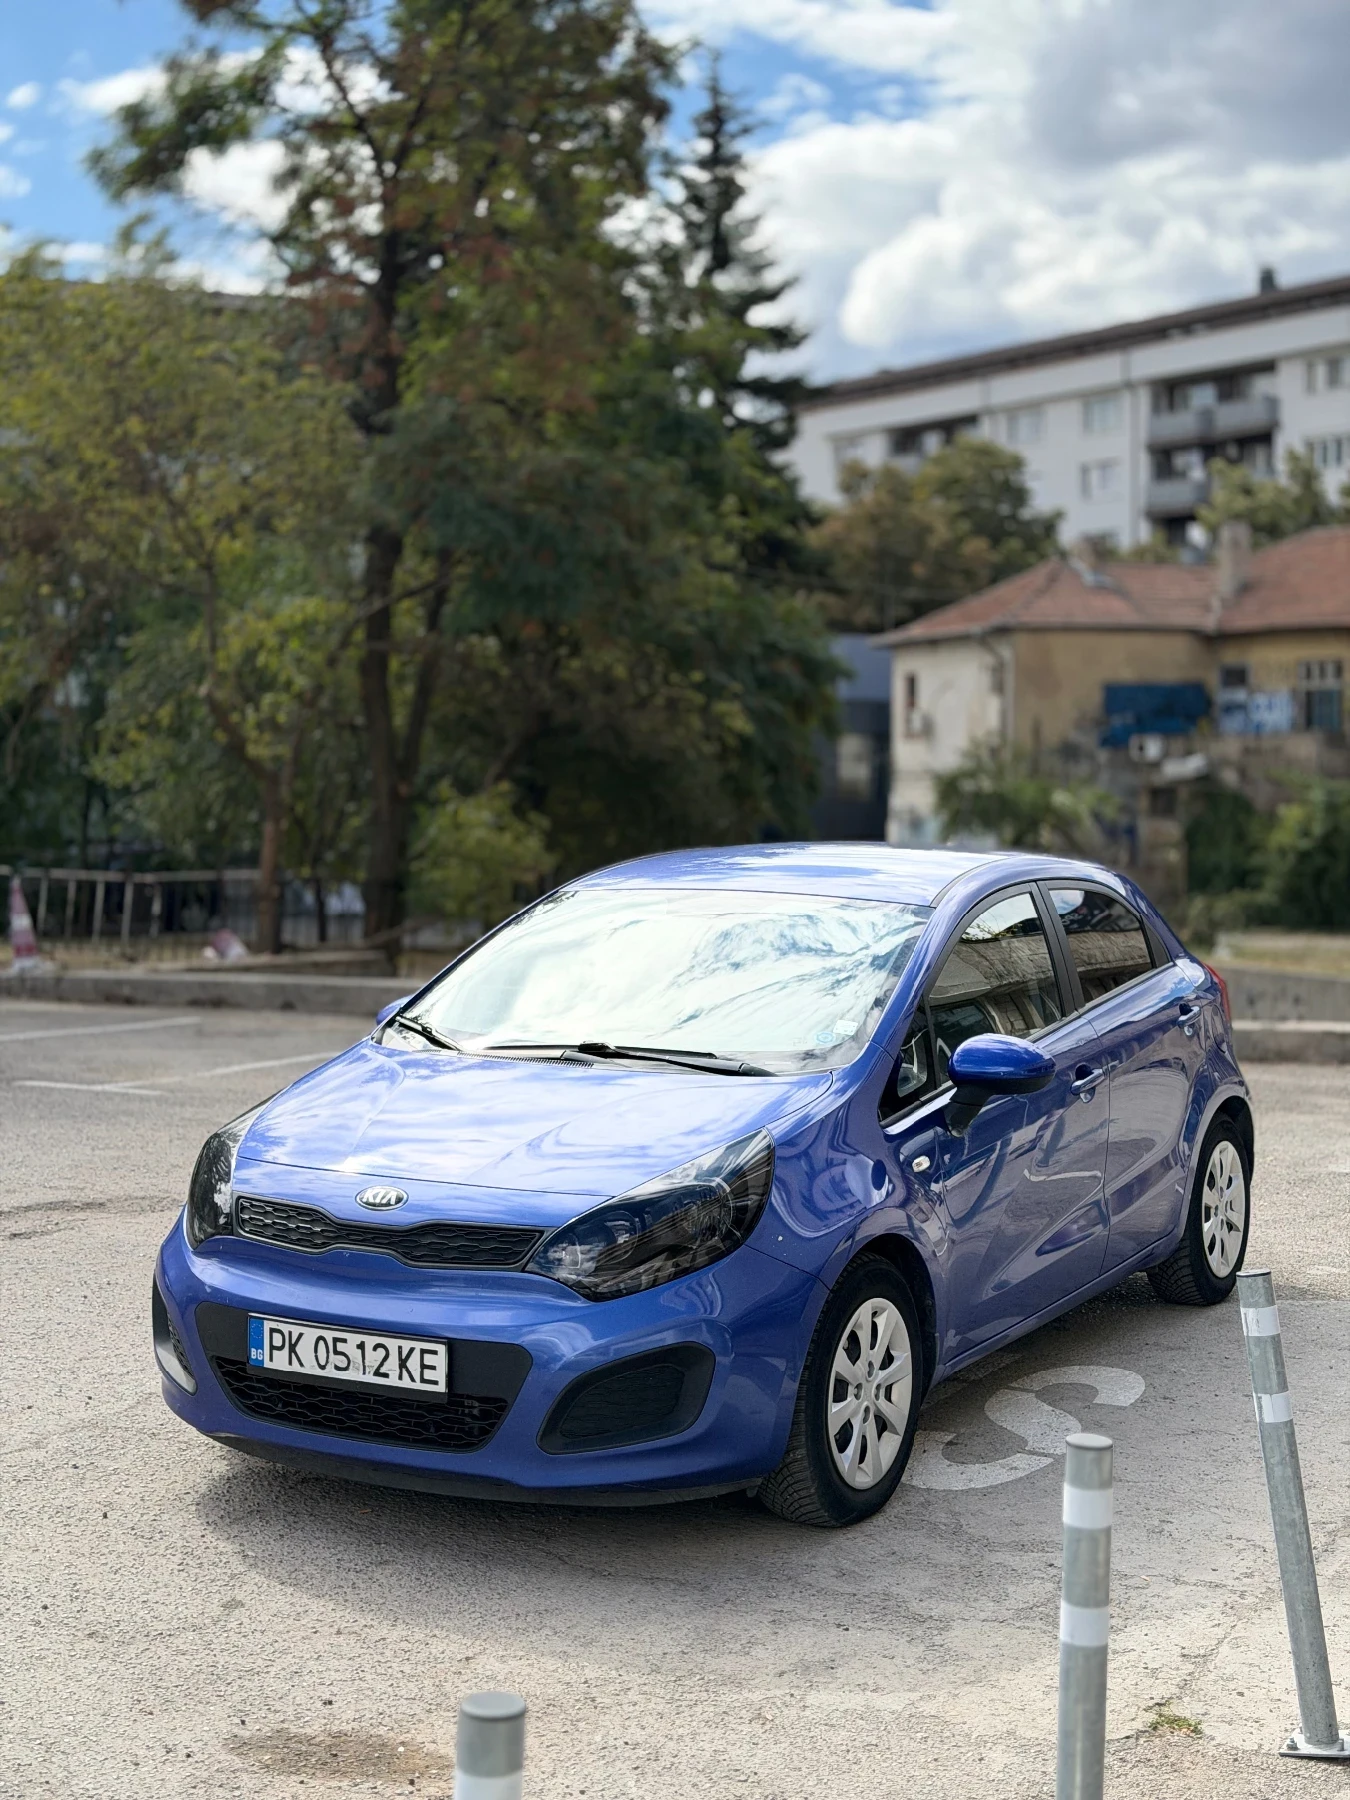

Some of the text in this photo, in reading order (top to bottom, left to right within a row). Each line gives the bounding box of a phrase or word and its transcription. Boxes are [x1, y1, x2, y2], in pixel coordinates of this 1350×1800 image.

[361, 1188, 398, 1205] KIA
[250, 1347, 264, 1361] BG
[268, 1327, 440, 1386] PK 0512 KE
